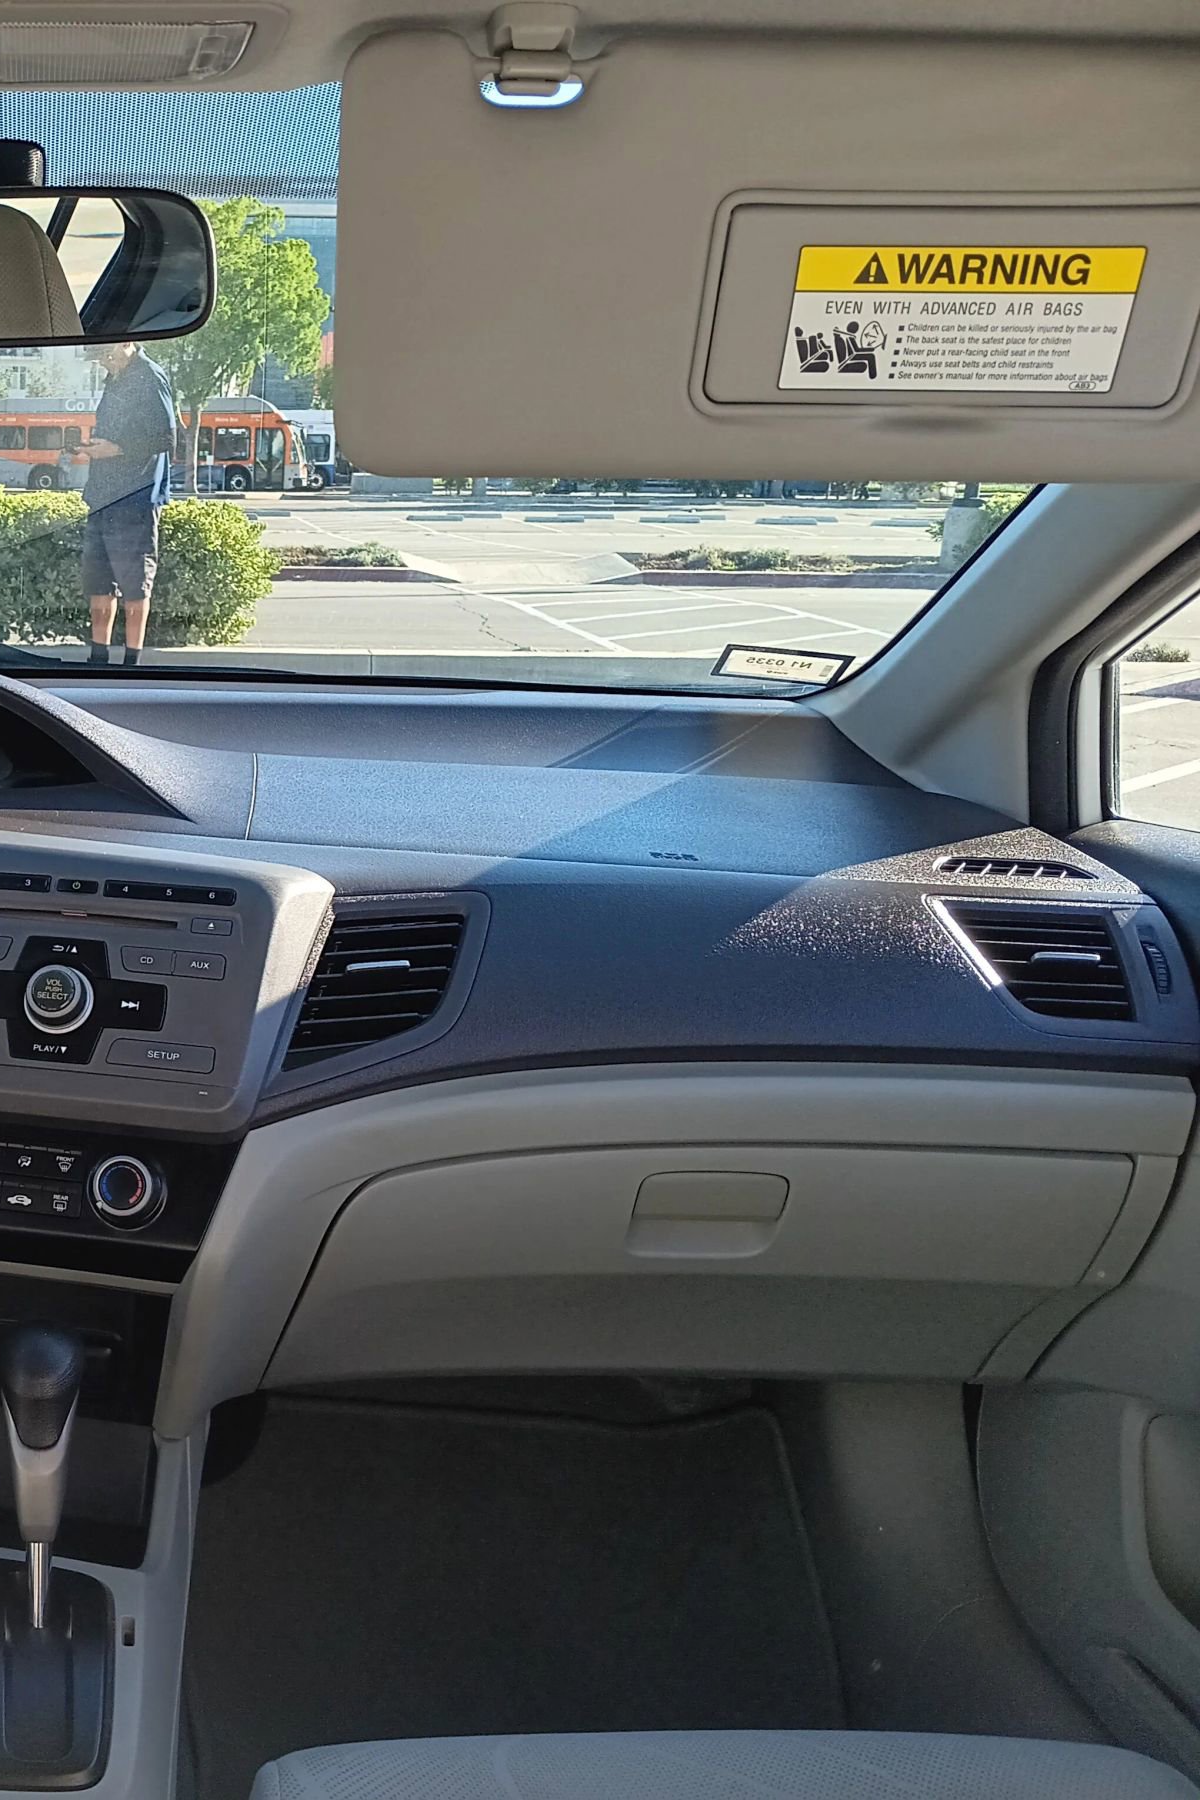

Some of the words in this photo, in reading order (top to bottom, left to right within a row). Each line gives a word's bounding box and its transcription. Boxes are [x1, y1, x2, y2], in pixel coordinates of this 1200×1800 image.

[898, 253, 1091, 285] WARNING
[825, 301, 863, 315] EVEN
[873, 301, 911, 315] WITH
[921, 302, 996, 316] ADVANCED
[1006, 303, 1034, 316] AIR
[1043, 303, 1083, 316] BAGS
[908, 324, 939, 332] Children
[958, 324, 966, 332] be
[968, 324, 988, 332] killed
[1037, 325, 1063, 334] injured
[1065, 325, 1074, 334] by
[1103, 325, 1117, 334] bag
[906, 336, 919, 344] The
[921, 336, 939, 344] back
[942, 336, 957, 344] seat
[1006, 337, 1026, 346] place
[903, 348, 924, 356] Never
[926, 348, 939, 358] put
[900, 360, 926, 369] Always
[898, 372, 911, 380] See
[914, 372, 943, 380] owner's
[1078, 373, 1088, 381] air
[1090, 373, 1108, 382] bags
[65, 399, 84, 411] Go
[122, 885, 129, 893] 4
[140, 956, 153, 964] CD
[190, 961, 210, 970] AUX
[46, 978, 62, 986] VOL
[37, 992, 68, 1000] SELECT
[147, 1051, 180, 1060] SETUP
